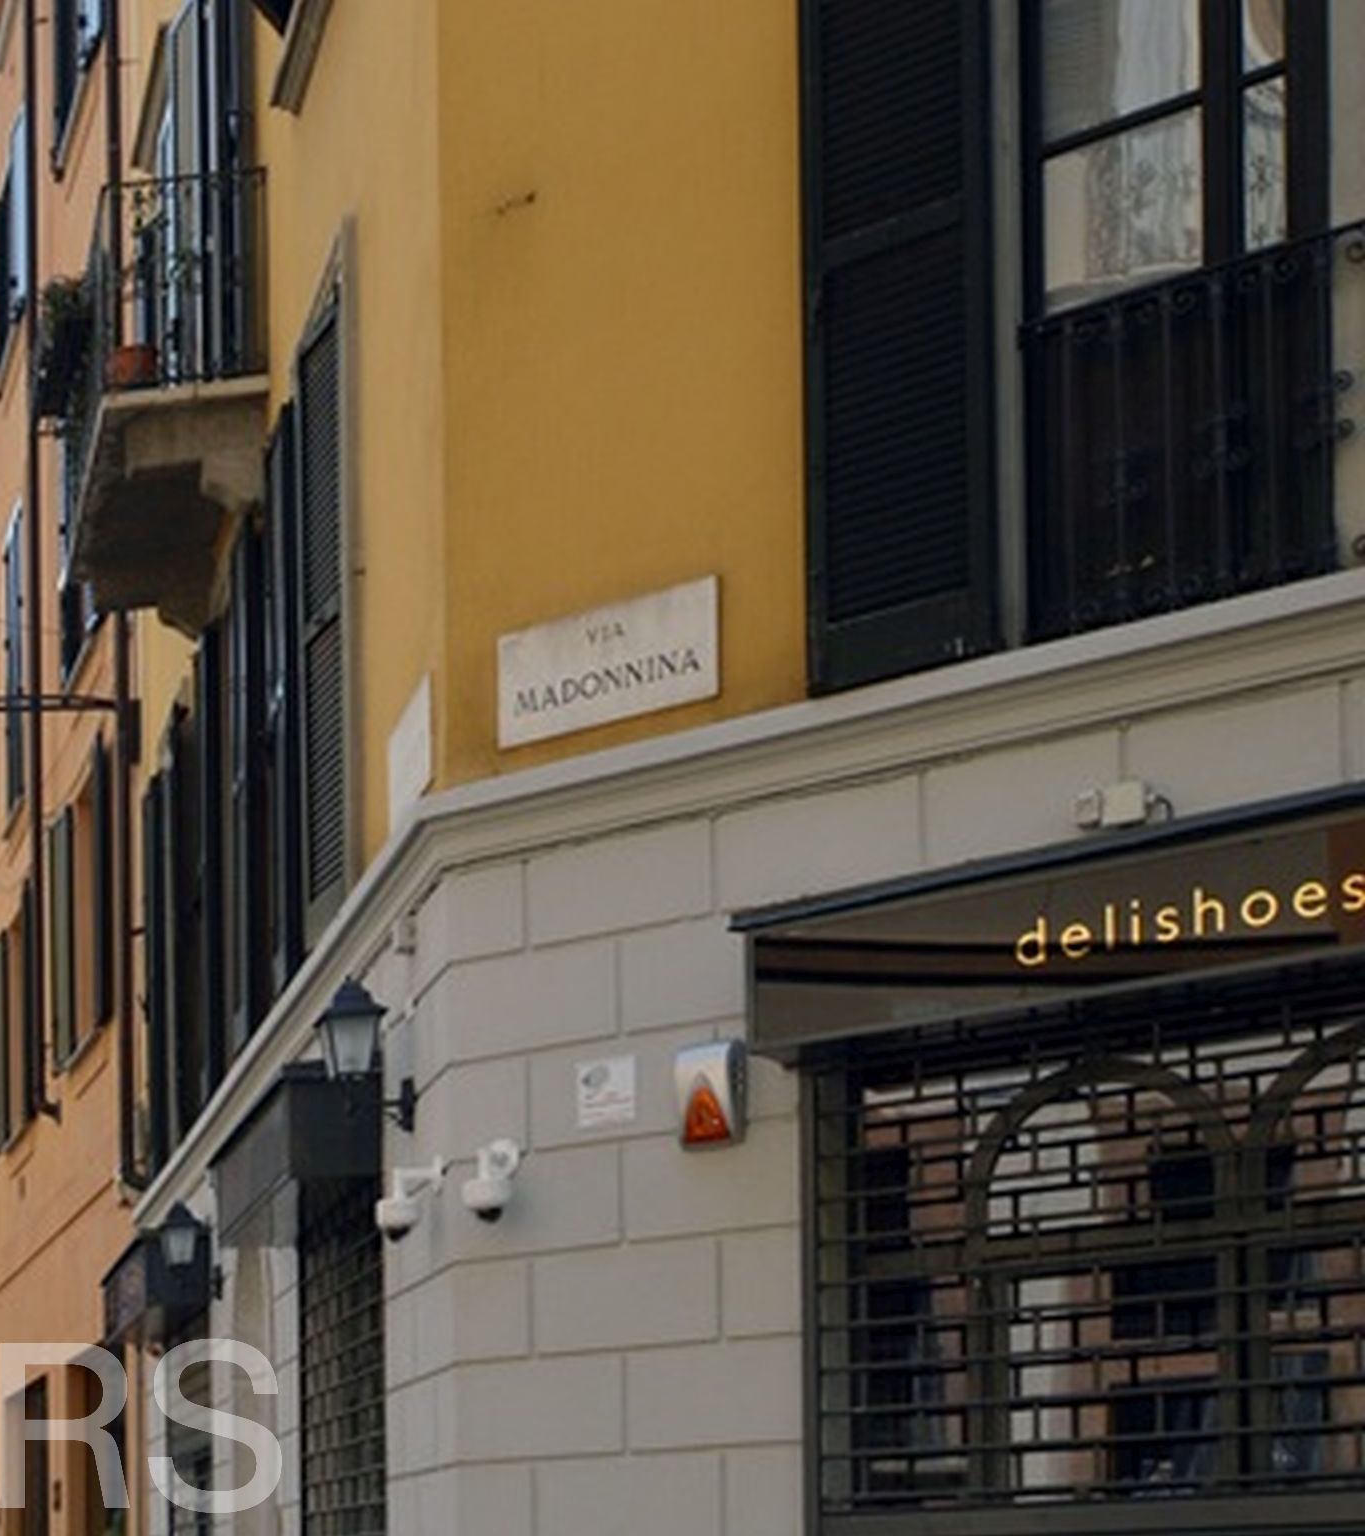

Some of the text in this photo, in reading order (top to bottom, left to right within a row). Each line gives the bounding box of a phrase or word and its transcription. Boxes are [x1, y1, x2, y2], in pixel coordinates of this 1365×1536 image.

[585, 622, 625, 645] VIA
[513, 648, 701, 717] MADONNINA
[1015, 872, 1365, 966] delishoes
